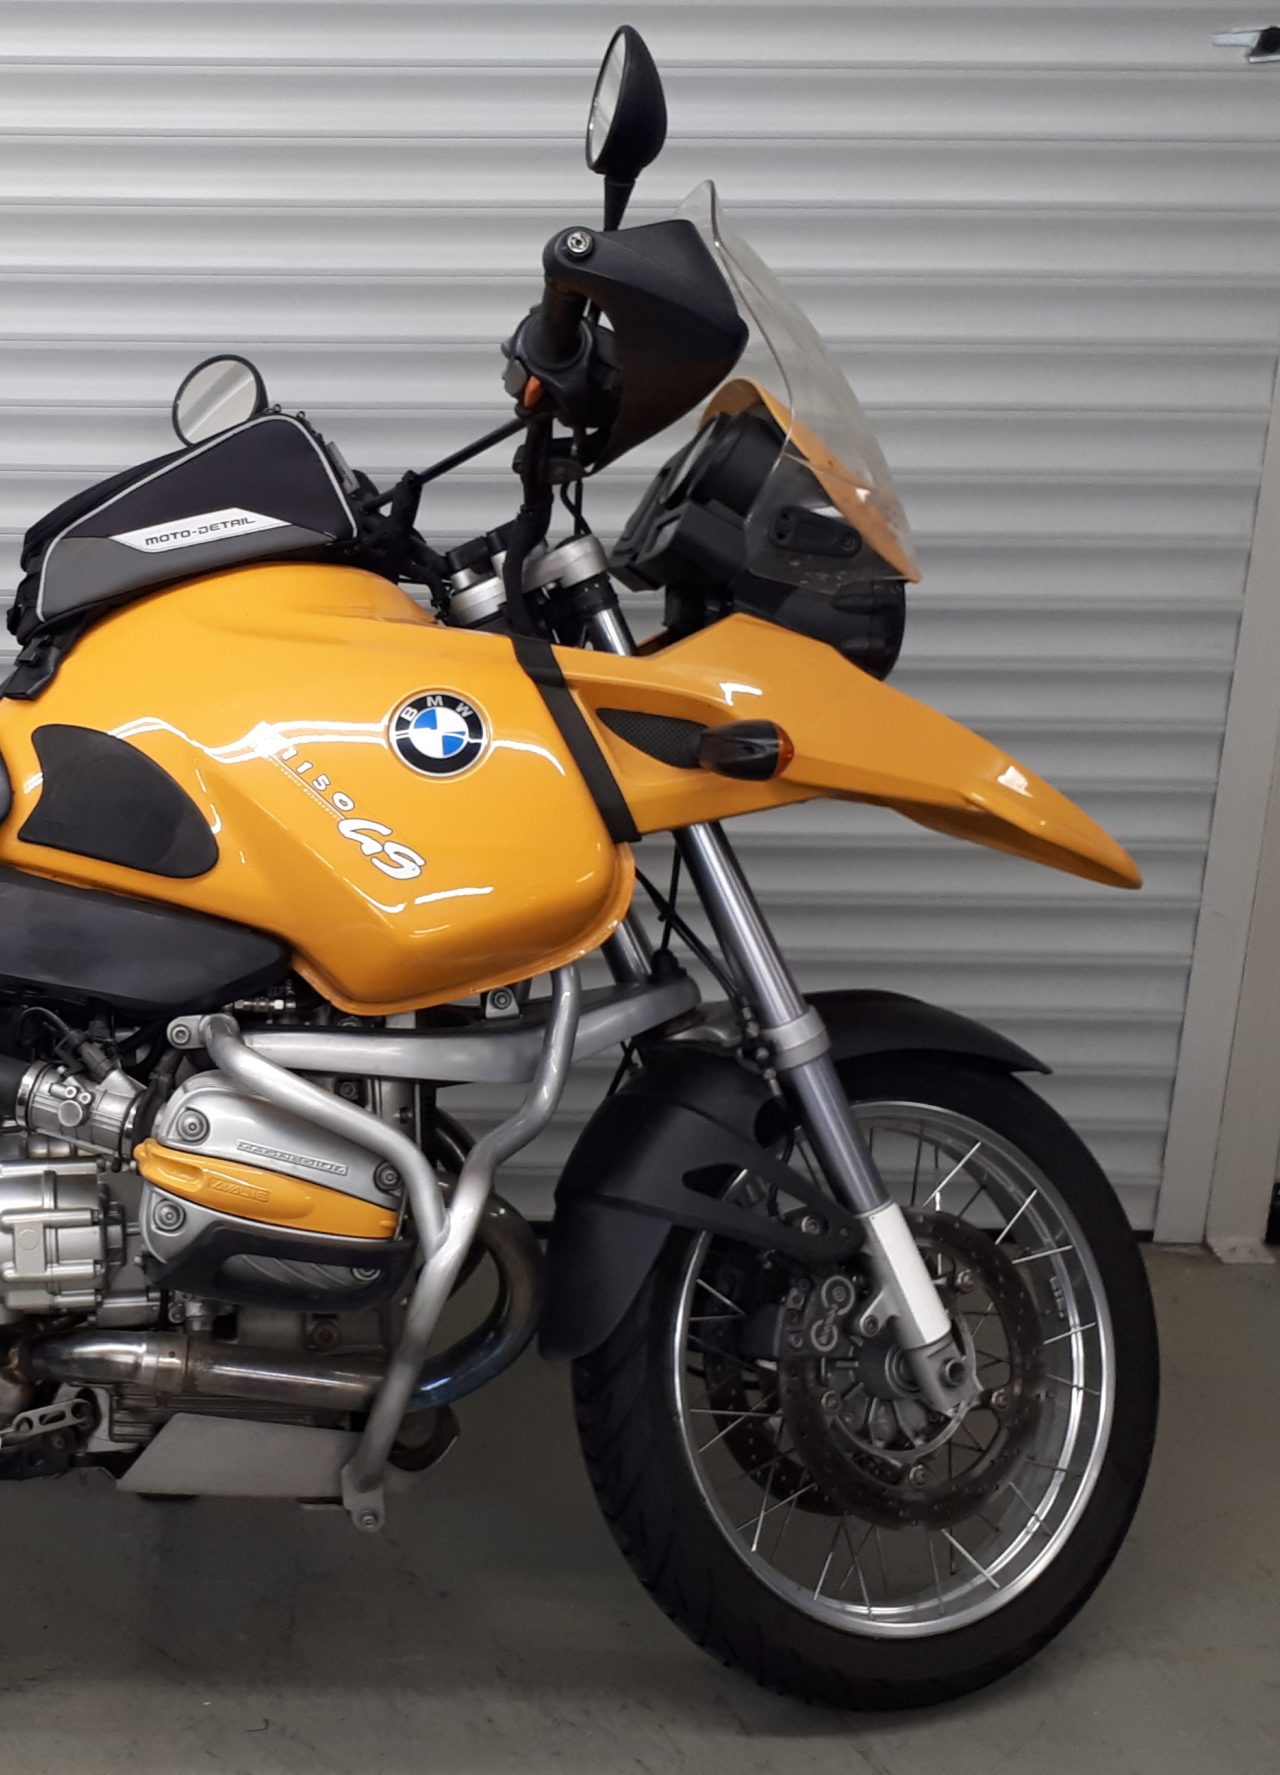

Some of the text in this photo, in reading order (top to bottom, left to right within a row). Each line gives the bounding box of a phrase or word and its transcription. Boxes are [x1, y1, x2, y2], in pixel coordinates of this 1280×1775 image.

[145, 517, 256, 546] MOTO-DETAIL
[400, 695, 474, 722] BMW
[337, 818, 427, 880] GS
